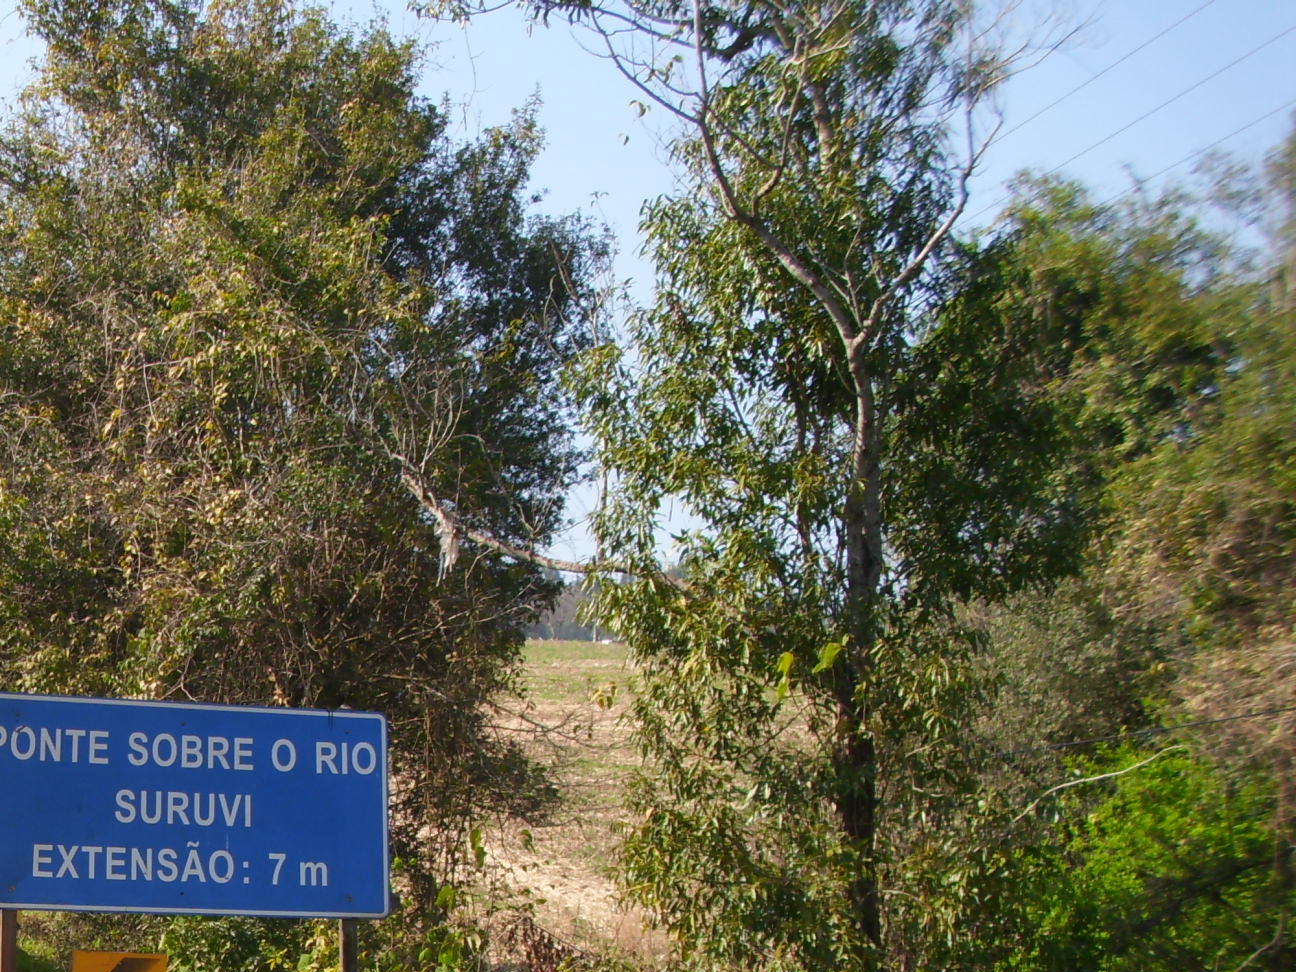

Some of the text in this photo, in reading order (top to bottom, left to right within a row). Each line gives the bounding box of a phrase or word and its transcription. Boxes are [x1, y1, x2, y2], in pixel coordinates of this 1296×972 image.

[127, 732, 254, 770] SOBRE
[271, 739, 297, 772] O
[315, 741, 377, 775] RIO
[114, 789, 253, 828] SURUVI
[32, 841, 329, 887] EXTENSÃO: 7 m
